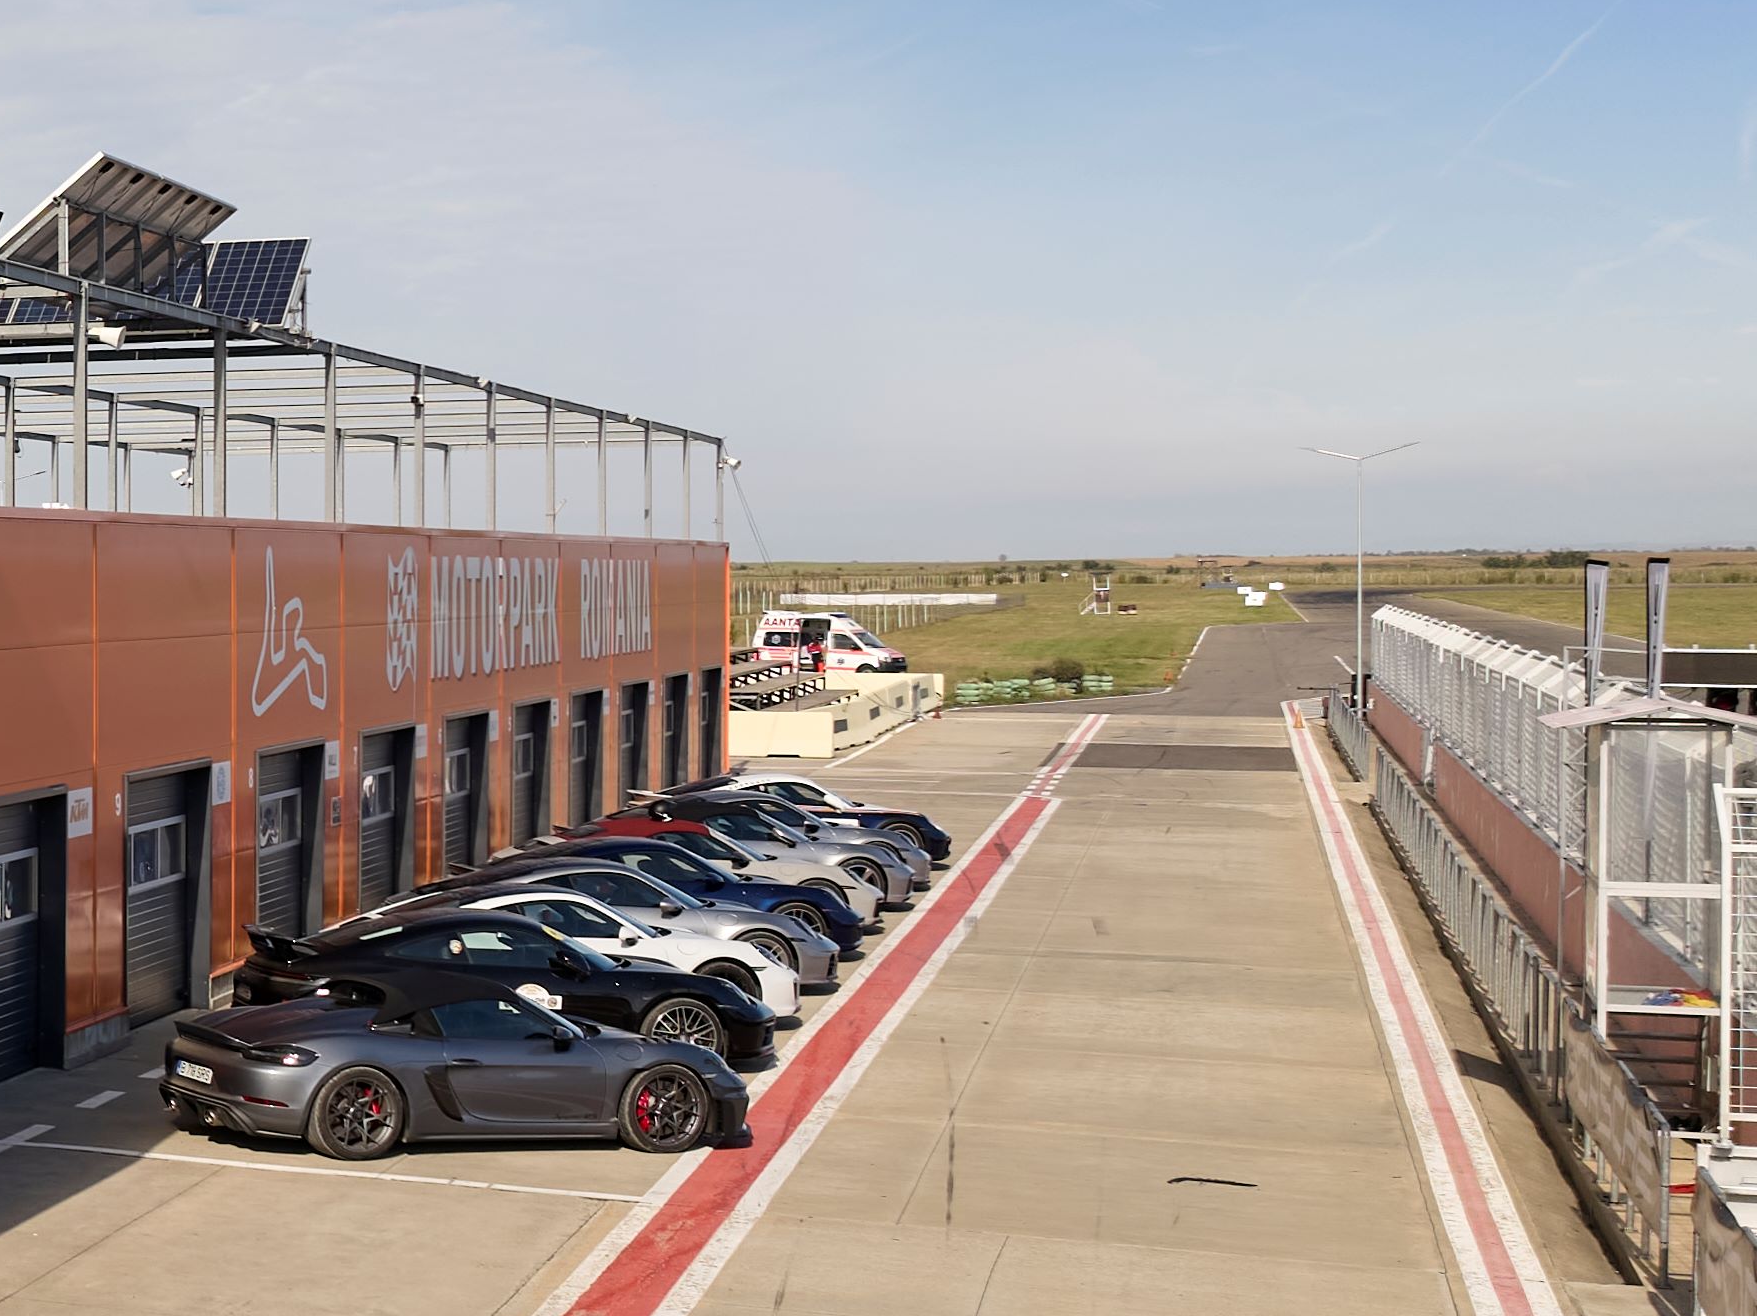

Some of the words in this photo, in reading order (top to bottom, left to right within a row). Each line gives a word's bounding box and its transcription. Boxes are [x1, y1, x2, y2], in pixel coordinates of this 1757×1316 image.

[430, 554, 560, 681] MOTORPARK
[580, 557, 652, 661] ROMANIA
[248, 767, 254, 789] 8
[69, 798, 89, 824] KTM
[114, 793, 122, 817] 9
